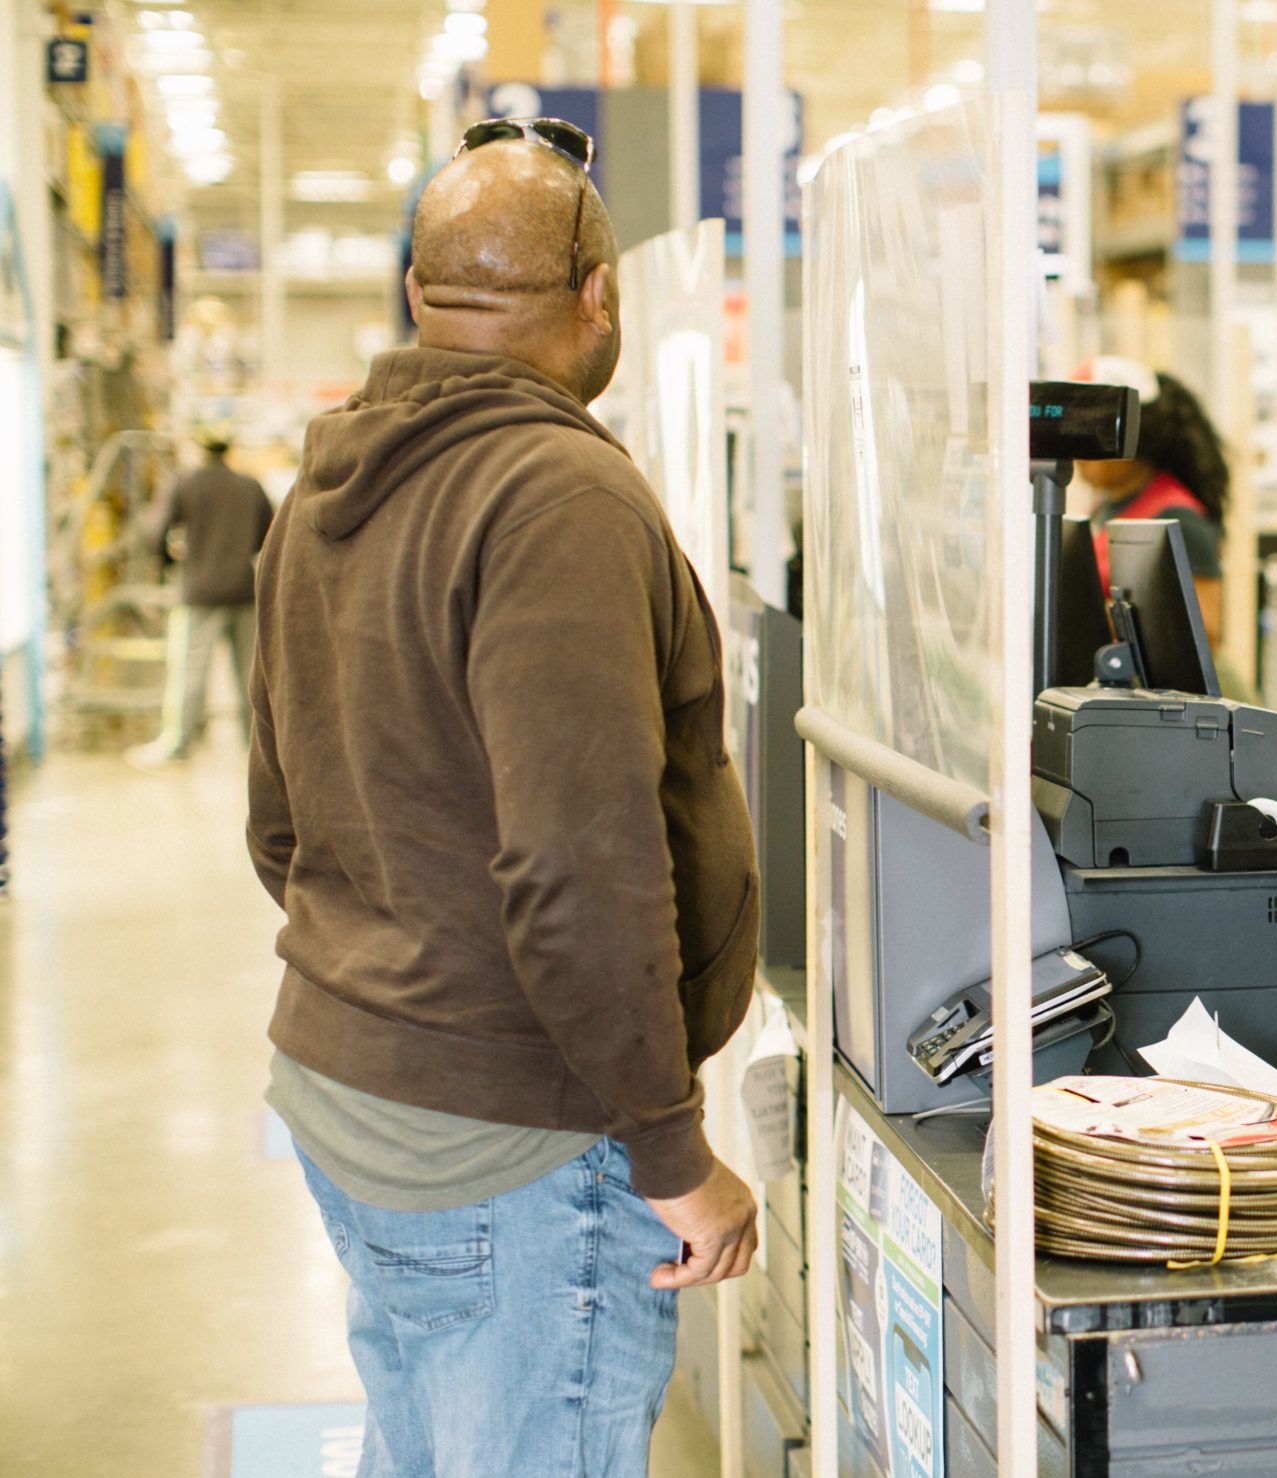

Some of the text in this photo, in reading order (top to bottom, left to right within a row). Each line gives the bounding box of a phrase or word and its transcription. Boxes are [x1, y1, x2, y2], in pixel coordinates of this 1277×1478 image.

[1044, 404, 1063, 418] FOR
[900, 1172, 929, 1229] FORGOT
[891, 1202, 910, 1247] YOUR
[911, 1221, 937, 1275] CARD?
[904, 1364, 919, 1402] TEXT
[897, 1394, 932, 1466] LOOKUP
